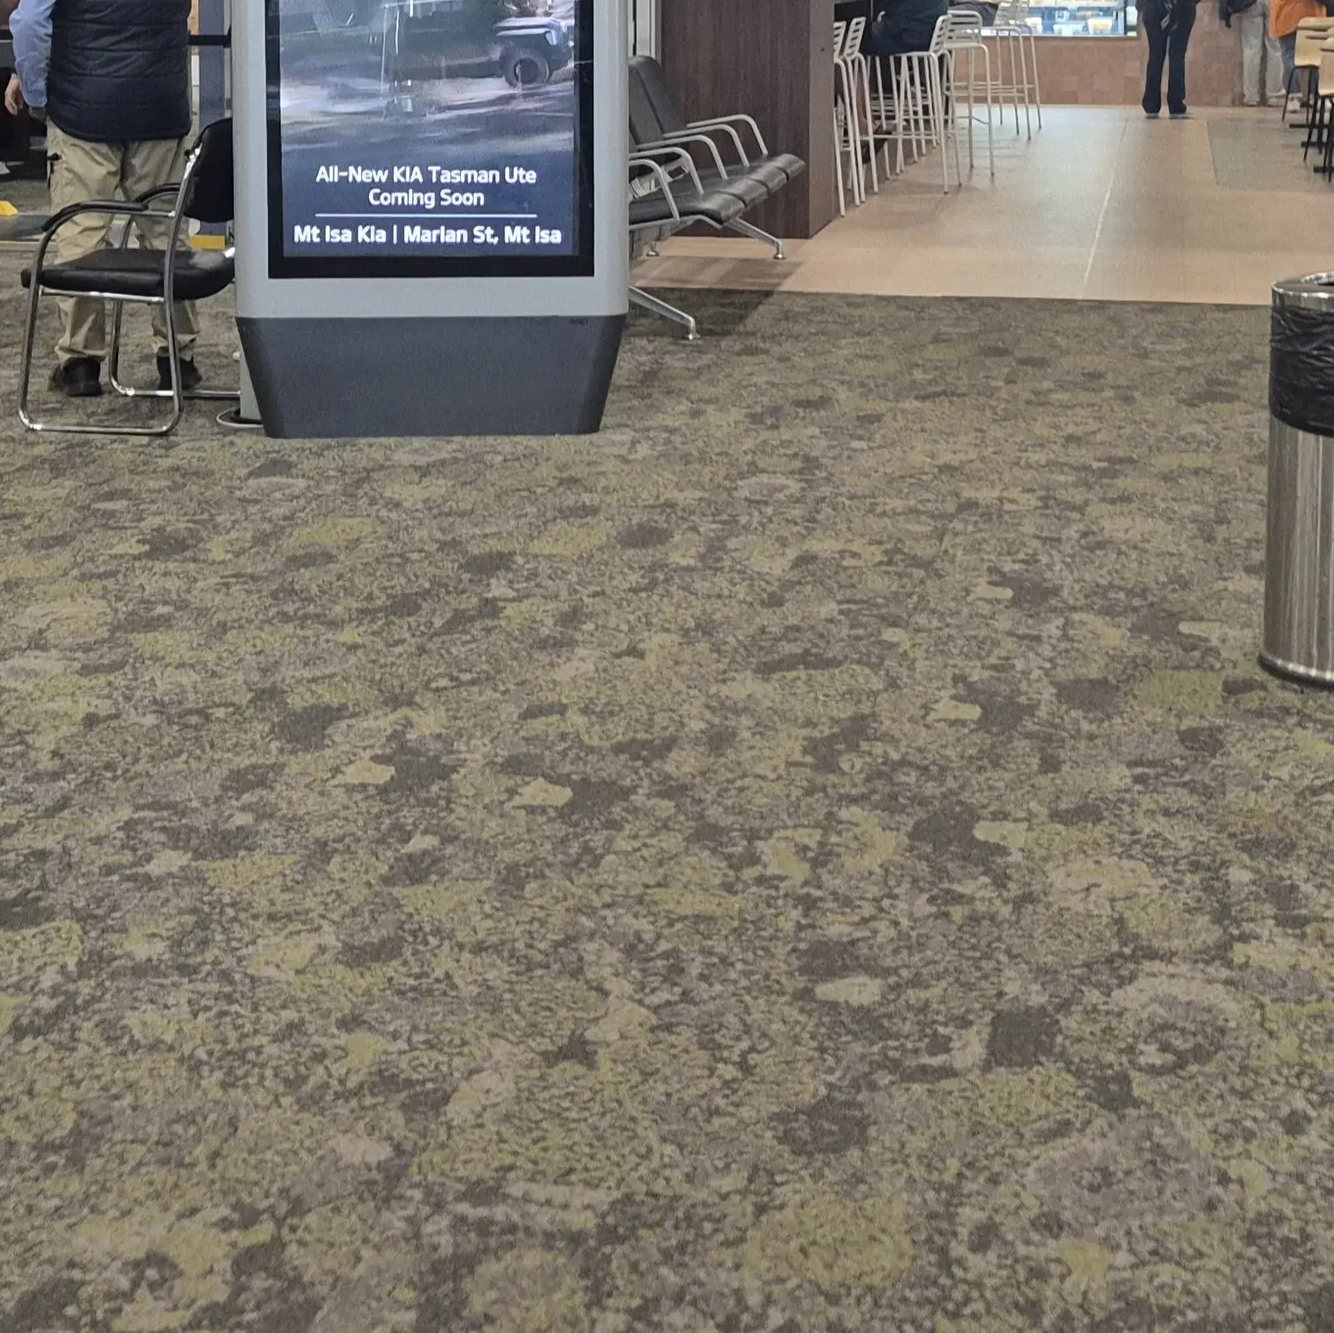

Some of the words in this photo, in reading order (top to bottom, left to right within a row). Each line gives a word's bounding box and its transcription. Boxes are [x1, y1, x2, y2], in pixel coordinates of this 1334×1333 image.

[316, 165, 388, 183] All-New
[393, 166, 423, 183] KIA
[427, 166, 500, 184] Tasman
[505, 166, 537, 184] Ute
[369, 189, 436, 209] Coming
[440, 189, 484, 206] Soon
[294, 225, 320, 243] Mt
[325, 225, 352, 243] Isa
[357, 225, 387, 243] Kia
[404, 225, 468, 244] Marian
[473, 225, 499, 245] St,
[504, 226, 530, 244] Mt
[535, 226, 562, 244] Isa
